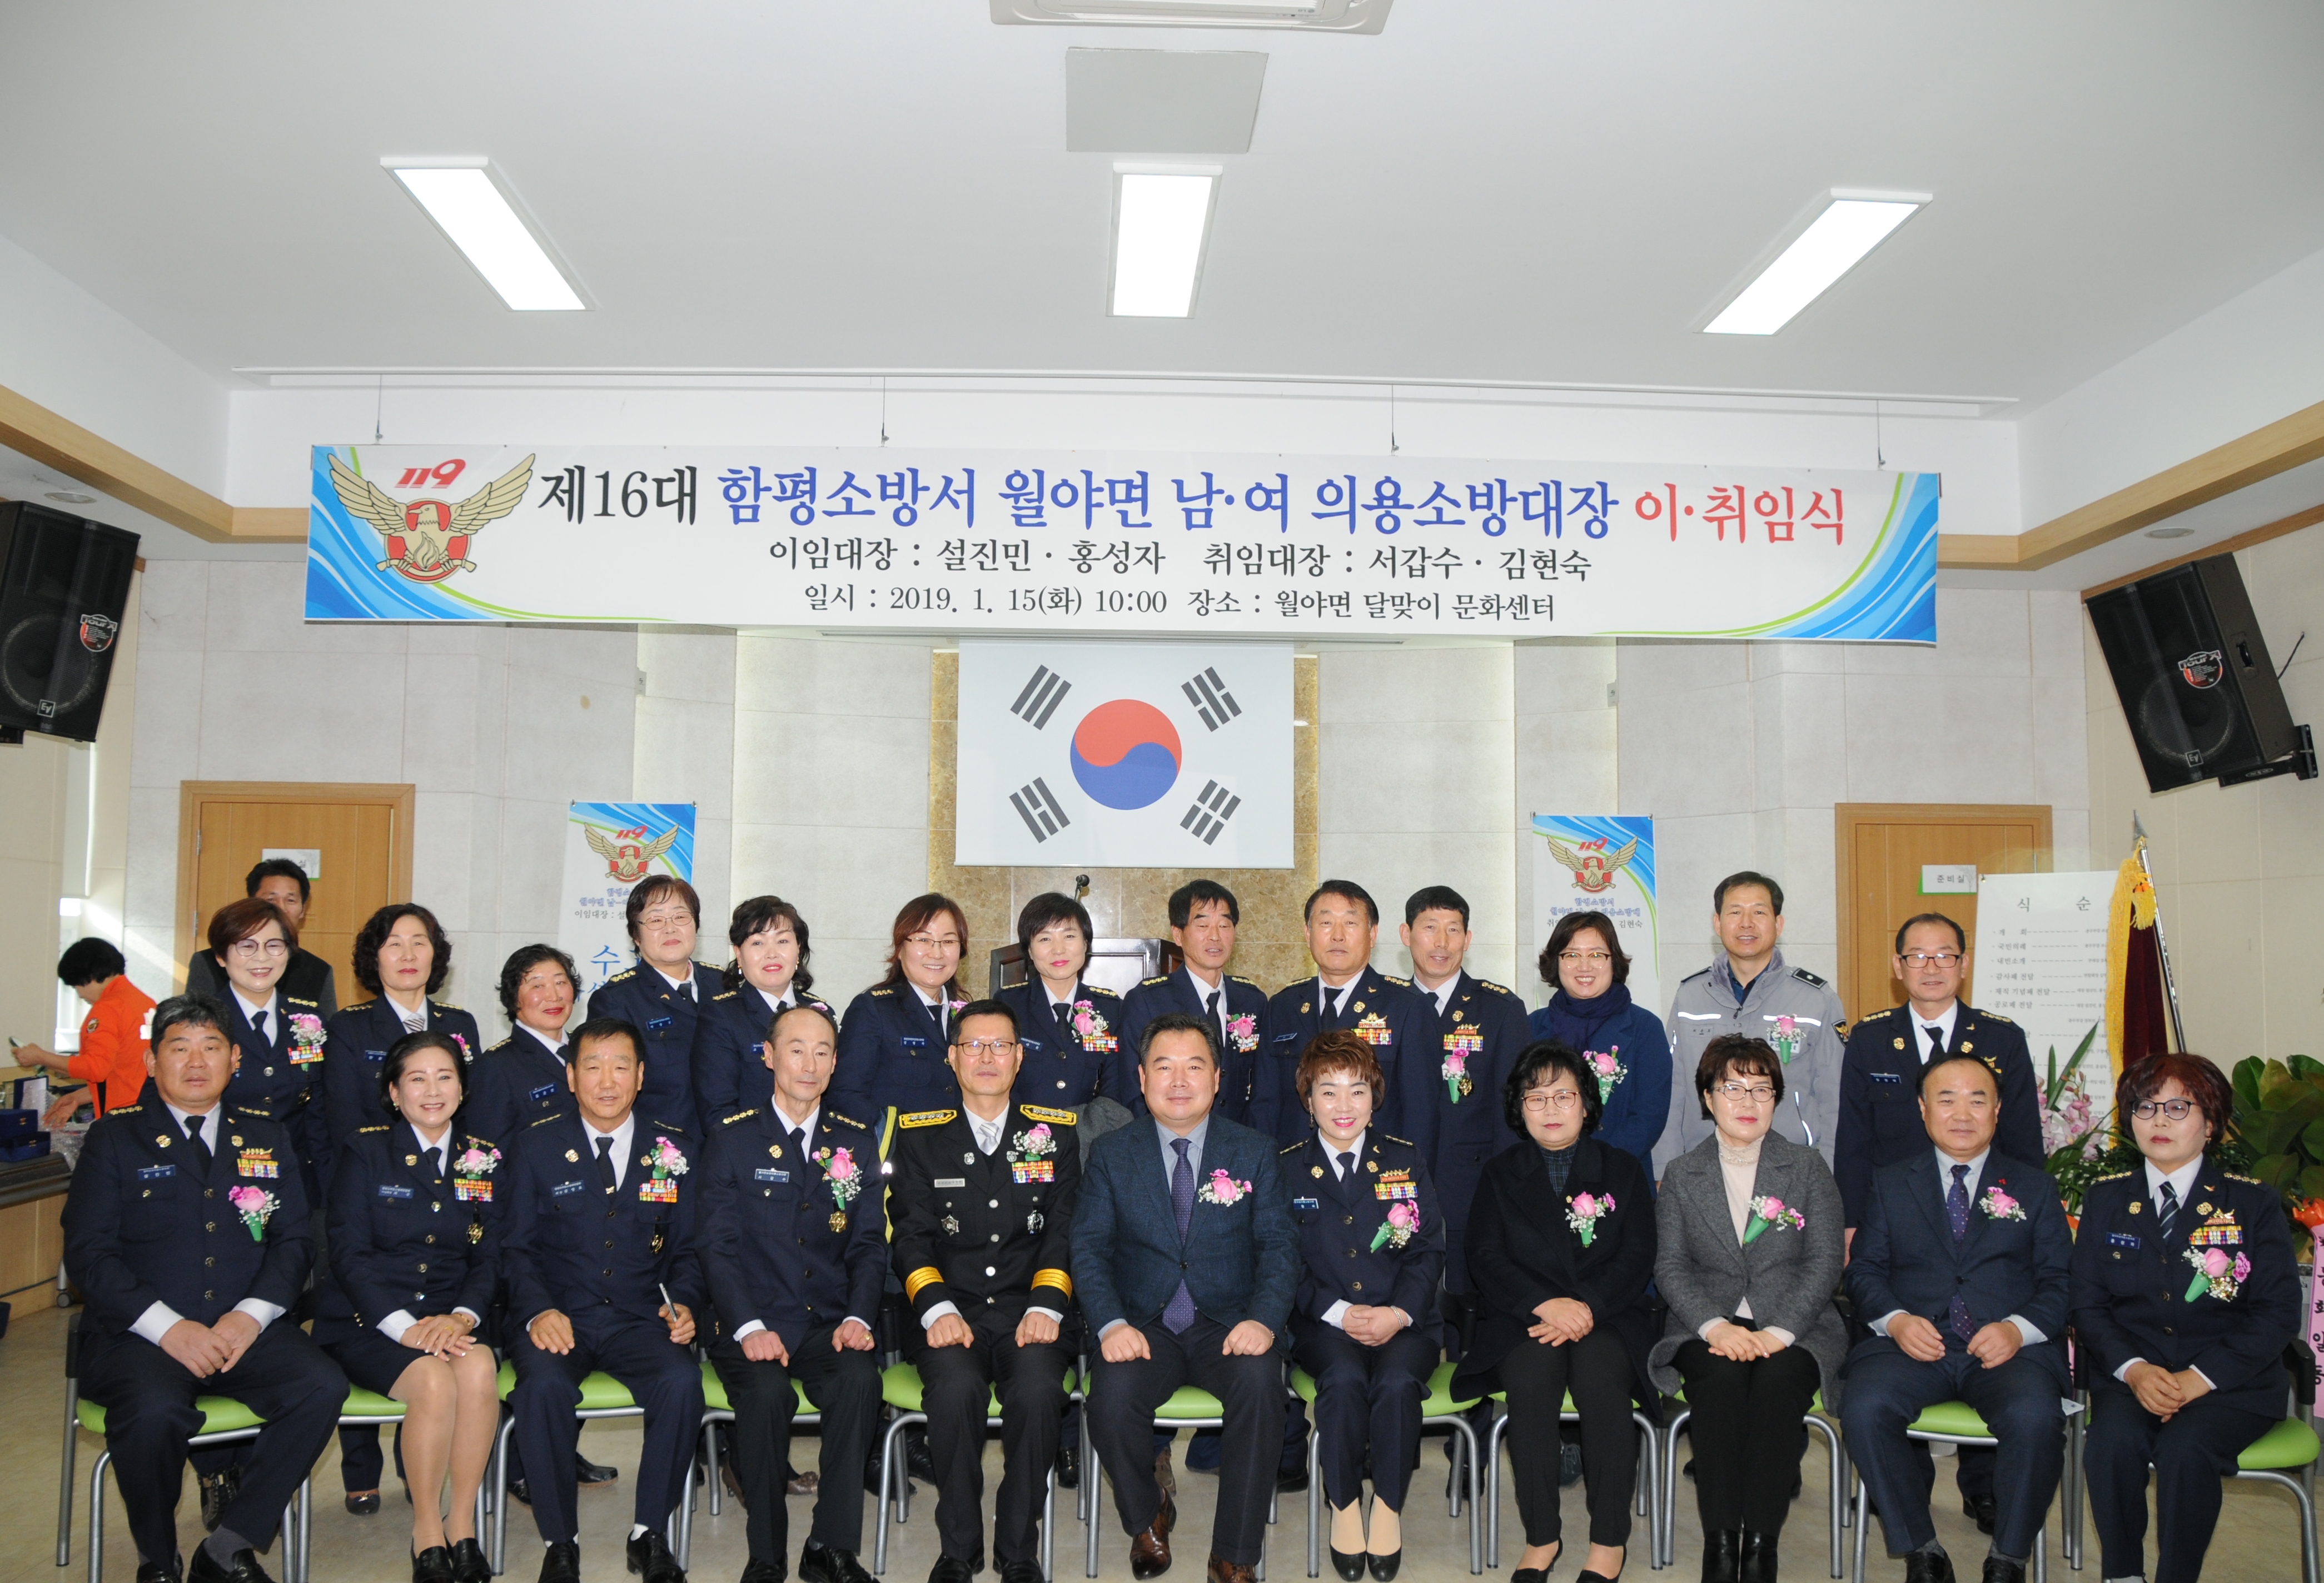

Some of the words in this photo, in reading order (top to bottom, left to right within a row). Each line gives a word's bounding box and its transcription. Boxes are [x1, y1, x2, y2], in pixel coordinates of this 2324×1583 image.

[395, 459, 466, 488] 119
[538, 465, 698, 526] 제16대
[717, 465, 975, 529] 함평소방서
[998, 469, 1153, 530] 월야면
[1171, 471, 1288, 534] 남·여
[1311, 474, 1620, 539] 의용소방대장
[1635, 482, 1844, 546] 이·취임식
[769, 536, 898, 571] 이임대장
[936, 538, 1031, 571] 설진민
[1067, 540, 1166, 575] 홍성자
[1203, 542, 1331, 578] 취임대장
[1368, 545, 1464, 580] 서갑수
[1499, 547, 1592, 582] 김현숙
[805, 583, 854, 612] 일시
[890, 587, 957, 613] 2019.
[973, 588, 993, 614] 1.
[1008, 586, 1082, 616] 15(화)
[1096, 590, 1167, 613] 10:00
[1187, 589, 1242, 616] 장소
[1274, 590, 1352, 619] 월야면
[1363, 591, 1439, 620] 달맞이
[1451, 593, 1554, 622] 문화센터
[615, 825, 649, 840] 119
[1578, 837, 1609, 852] 119
[1937, 874, 1965, 883] 준비실
[574, 910, 608, 919] 이임대장
[1619, 919, 1643, 929] 김현숙
